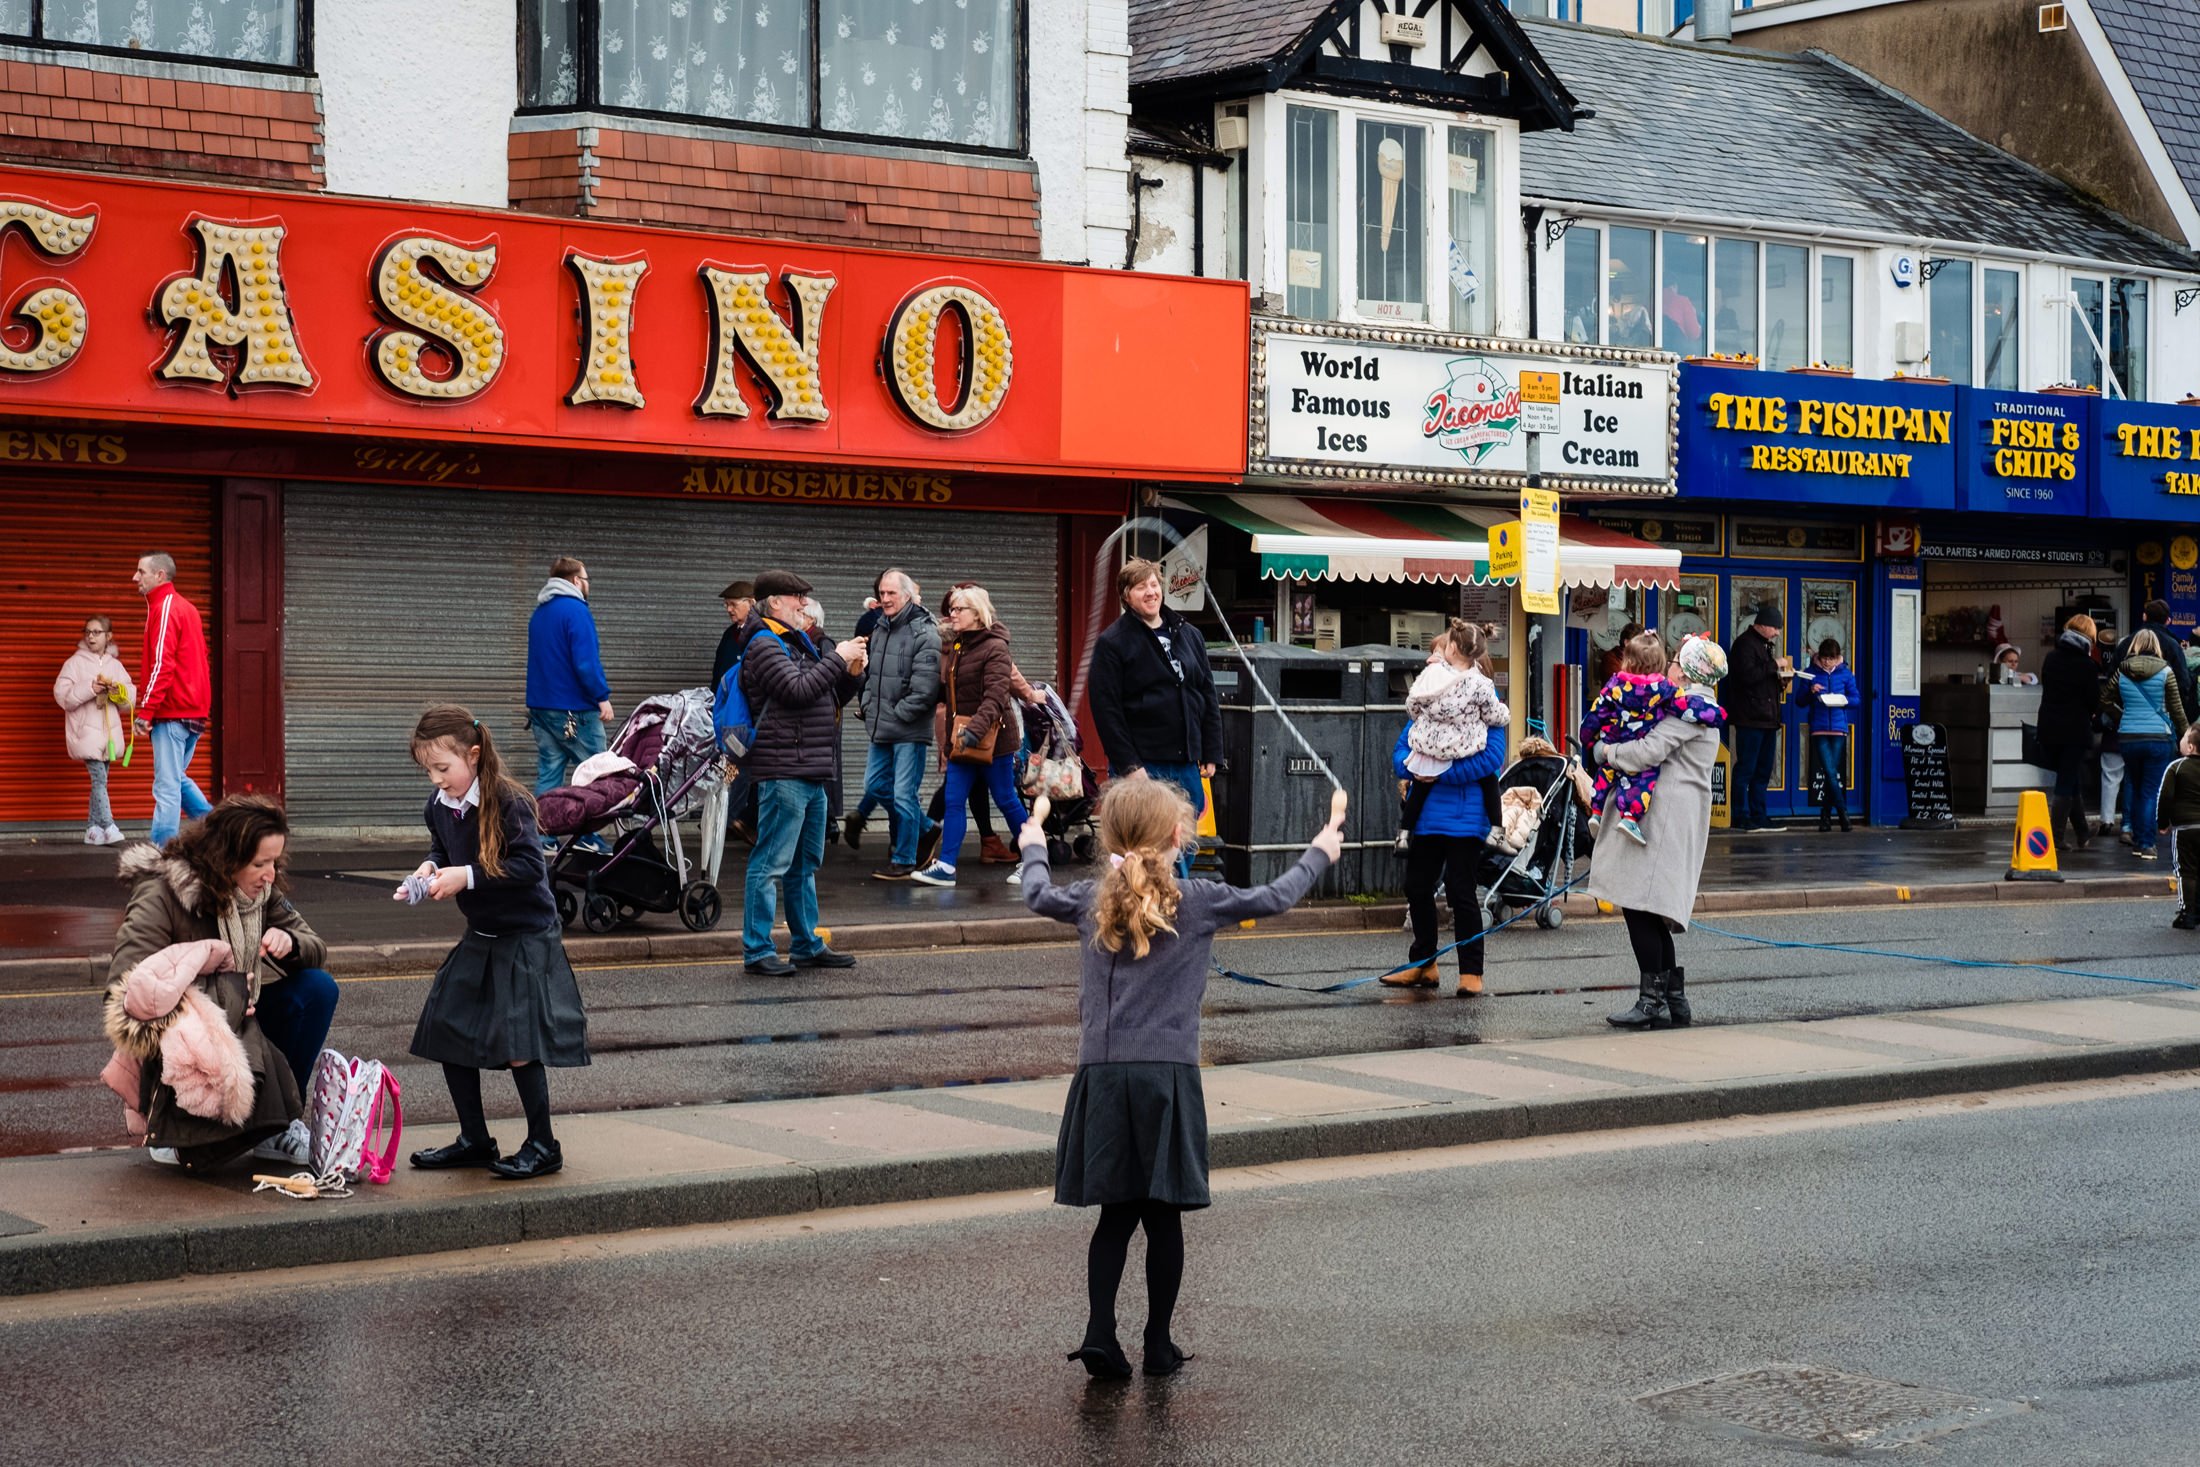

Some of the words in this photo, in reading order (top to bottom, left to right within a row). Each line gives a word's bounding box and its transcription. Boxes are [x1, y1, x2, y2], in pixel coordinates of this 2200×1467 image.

[1398, 22, 1423, 32] REGAL
[0, 199, 1013, 431] CASINO
[1377, 304, 1393, 314] HOT
[1395, 305, 1401, 315] &
[1301, 351, 1380, 382] World
[1562, 371, 1643, 399] Italian
[1291, 388, 1391, 419] Famous
[1424, 391, 1520, 434] Jaconell
[1994, 402, 2066, 418] TRADITIONAL
[1583, 410, 1618, 434] Ice
[1709, 393, 1788, 434] THE
[1798, 399, 1951, 444] FISHPAN
[1317, 426, 1368, 453] Ices
[1991, 418, 2055, 449] FISH
[2062, 422, 2080, 451] &
[2117, 422, 2182, 460] THE
[353, 447, 482, 482] Gilly's
[1562, 441, 1639, 468] Cream
[1751, 445, 1913, 479] RESTAURANT
[1994, 448, 2076, 481] CHIPS
[682, 466, 953, 503] AMUSEMENTS
[2006, 487, 2030, 498] SINCE
[2034, 489, 2054, 500] 1960
[1492, 560, 1518, 572] Suspension
[1496, 551, 1513, 560] Parking
[1946, 546, 1977, 558] PARTIES
[1984, 549, 2010, 559] ARMED
[2012, 549, 2040, 560] FORCES
[2048, 552, 2083, 562] STUDENTS
[2172, 571, 2194, 584] Family
[2172, 582, 2196, 593] Owned
[1889, 704, 1915, 719] Beers
[1889, 728, 1901, 741] Wi
[1904, 745, 1925, 755] Morning
[1927, 746, 1947, 756] Special
